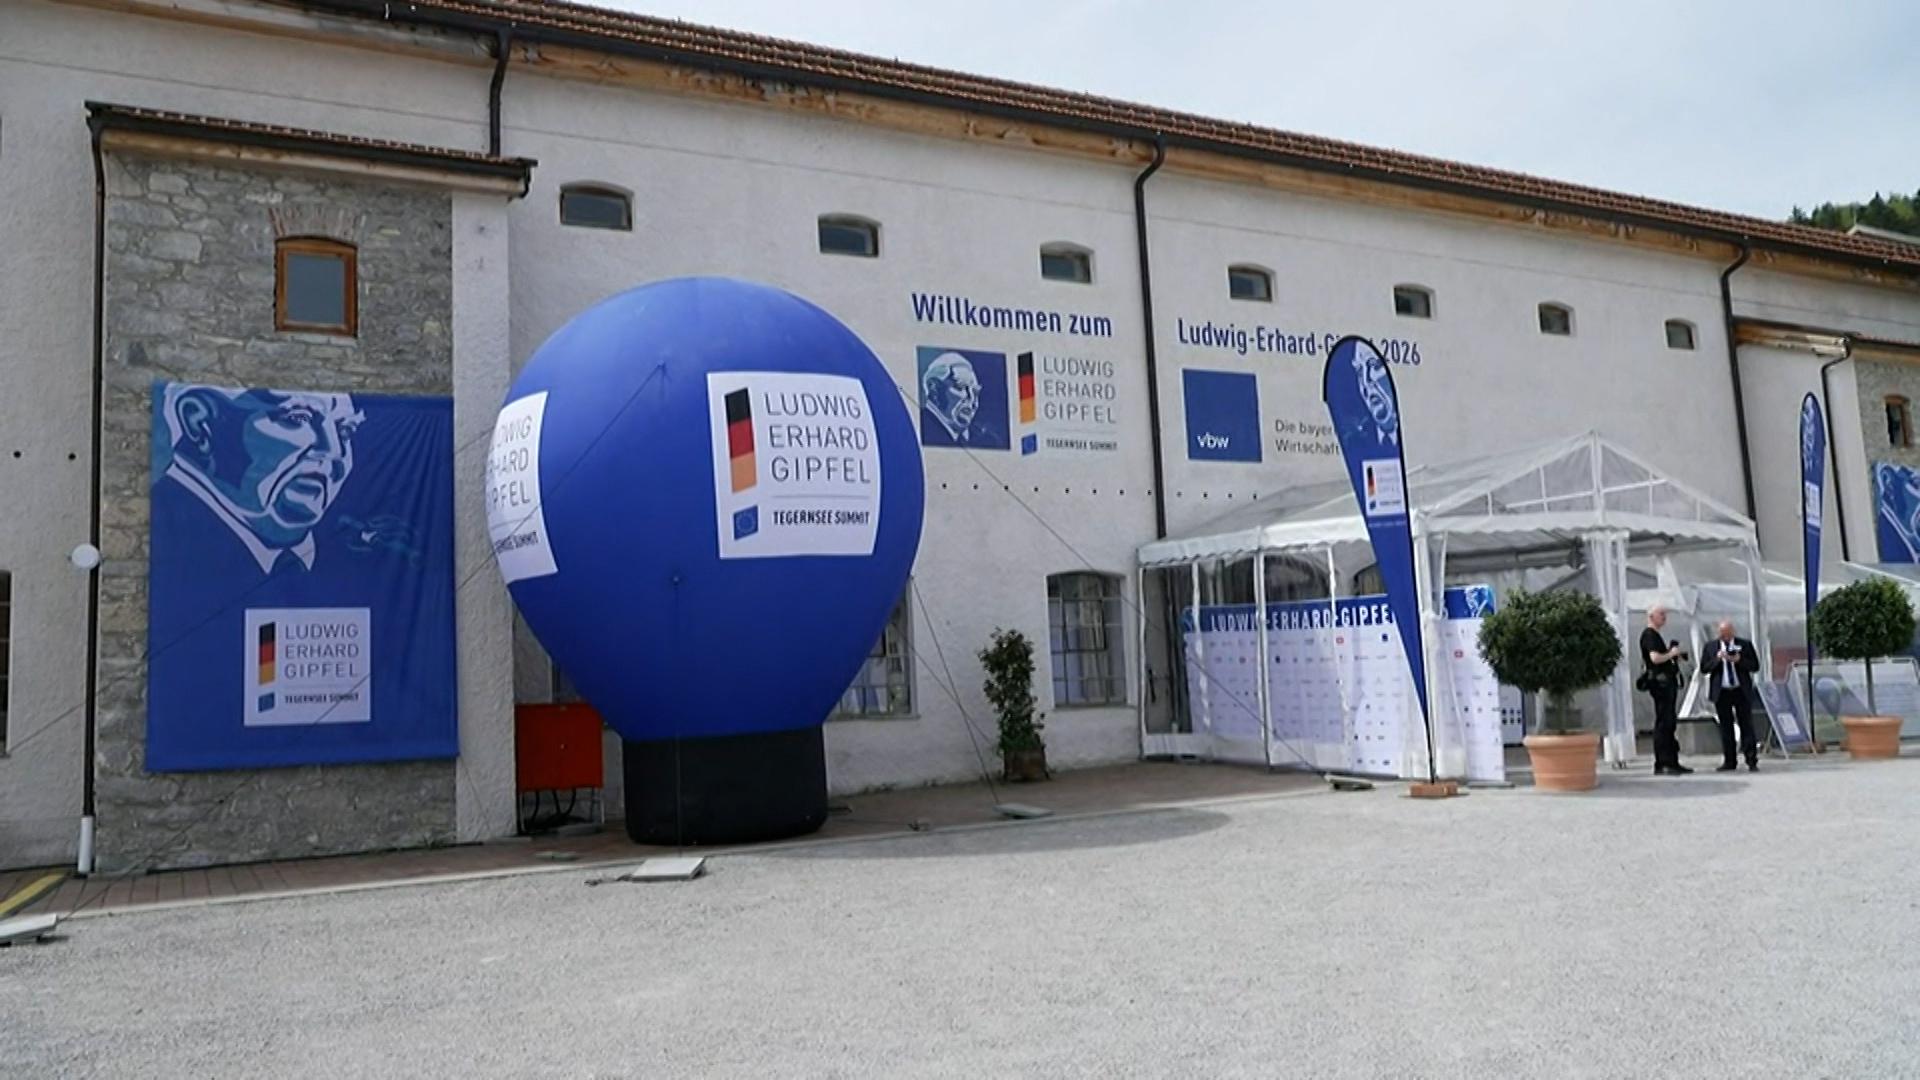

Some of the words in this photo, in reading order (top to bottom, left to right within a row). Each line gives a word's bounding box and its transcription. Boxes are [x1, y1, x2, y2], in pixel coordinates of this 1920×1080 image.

[912, 293, 1061, 334] Willkommen
[1069, 313, 1113, 339] zum
[1178, 318, 1373, 357] Ludwig-Erhard-G
[1381, 338, 1421, 366] 2026
[1043, 356, 1115, 378] LUDWIG
[1044, 379, 1116, 400] ERHARD
[764, 391, 862, 419] LUDWIG
[1044, 401, 1117, 424] GIPFEL
[1275, 419, 1296, 434] Die
[769, 425, 870, 452] ERHARD
[1196, 432, 1230, 451] vbw
[771, 456, 872, 485] GIPFEL
[773, 509, 833, 526] TEGERNSEE
[833, 509, 870, 525] SUMMIT
[1211, 602, 1396, 632] LUDWI-ERHARD-GIPFE
[284, 623, 359, 640] LUDWIG
[285, 643, 359, 660] ERHARD
[284, 662, 359, 680] GIPFEL
